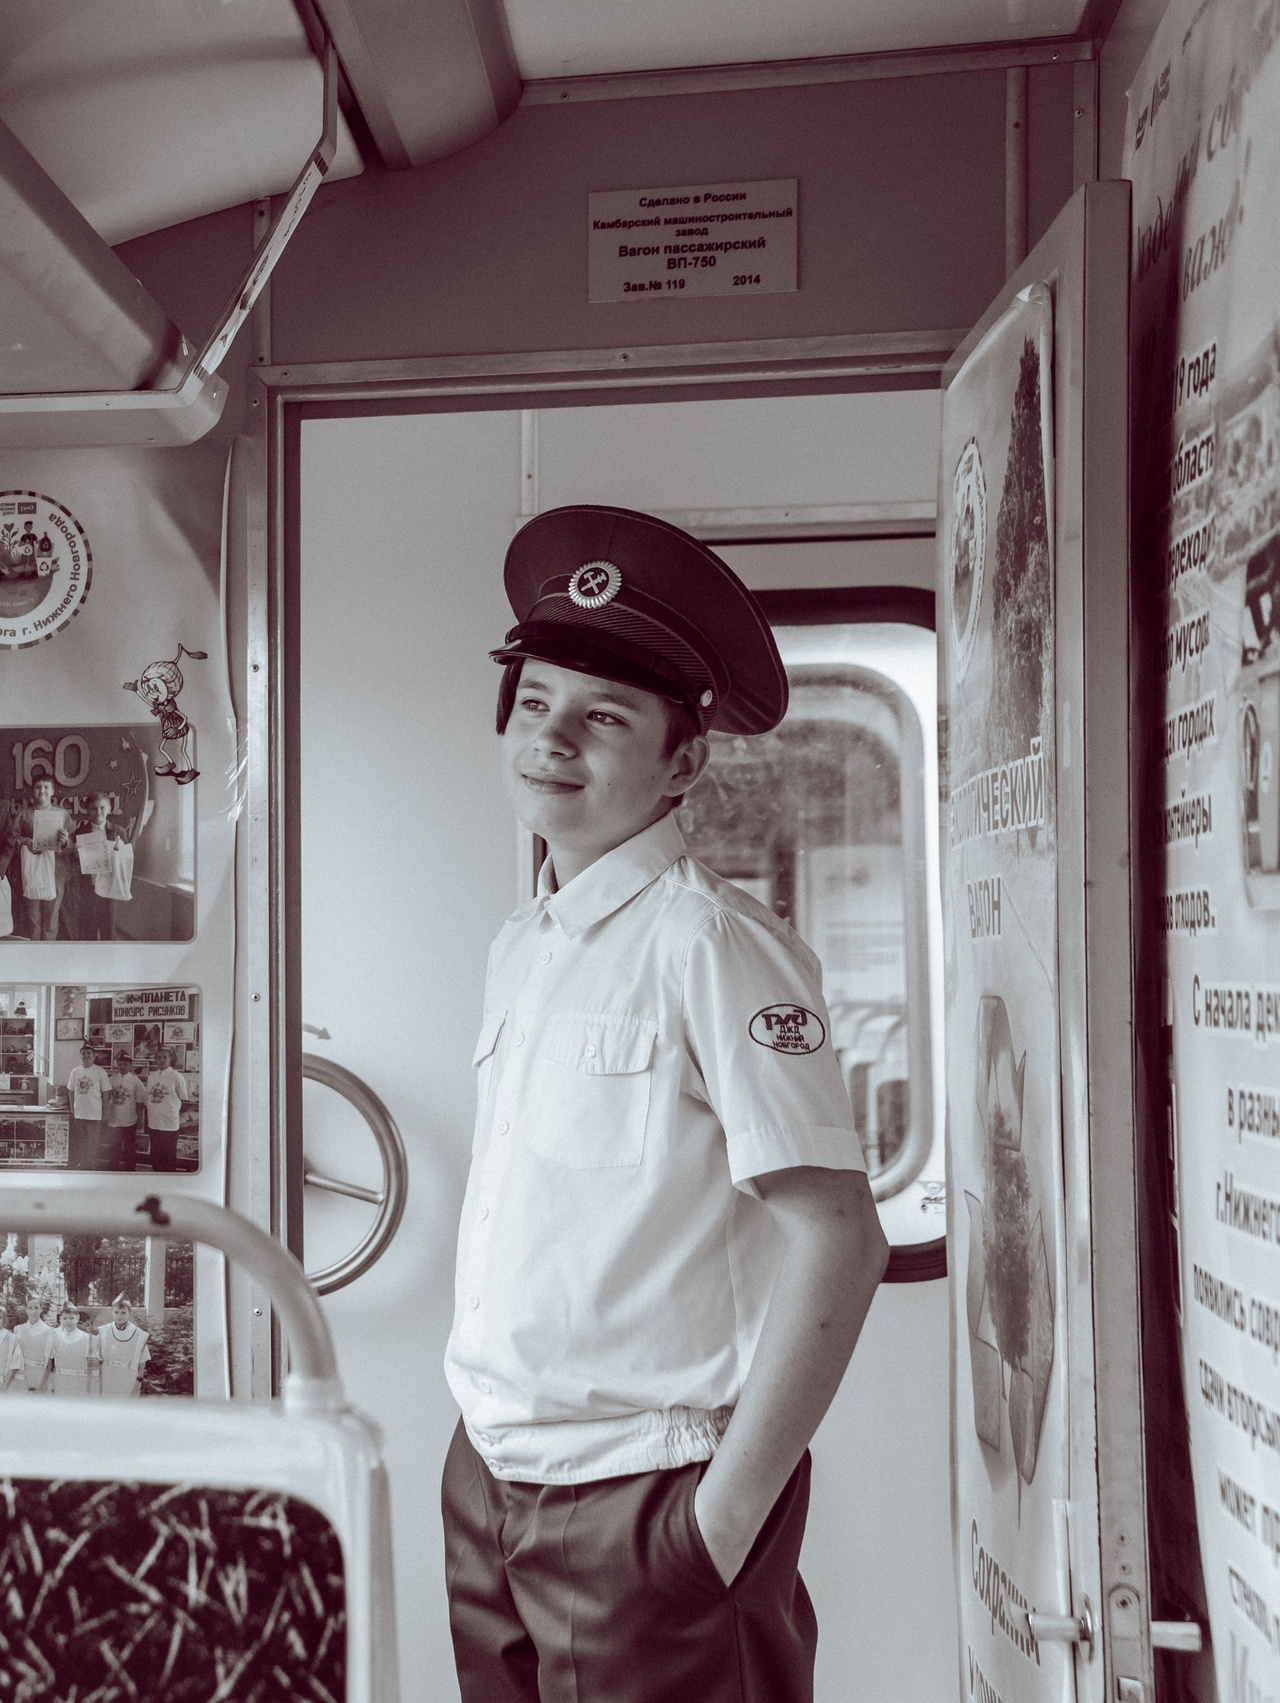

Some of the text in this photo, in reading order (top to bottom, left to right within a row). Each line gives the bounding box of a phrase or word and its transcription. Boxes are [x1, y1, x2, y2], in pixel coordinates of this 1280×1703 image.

[593, 207, 793, 230] Камбарский машиностроительный
[639, 196, 690, 208] Сделано
[703, 192, 747, 203] России
[618, 237, 766, 257] Вагон пассажирский
[675, 226, 709, 237] завод
[666, 279, 686, 290] 119
[732, 274, 761, 286] 2014
[667, 255, 717, 270] ВП-750
[1187, 343, 1217, 399] года
[48, 512, 81, 582] Новгорода
[33, 583, 78, 631] Нижнего
[1177, 697, 1215, 760] городах
[12, 734, 90, 790] 160
[967, 877, 1002, 938] ВАГОН
[1175, 890, 1216, 936] отходов.
[114, 1005, 186, 1018] КОНКУРС РИСУНКОВ
[1193, 974, 1201, 1026] С
[1205, 989, 1251, 1030] начала
